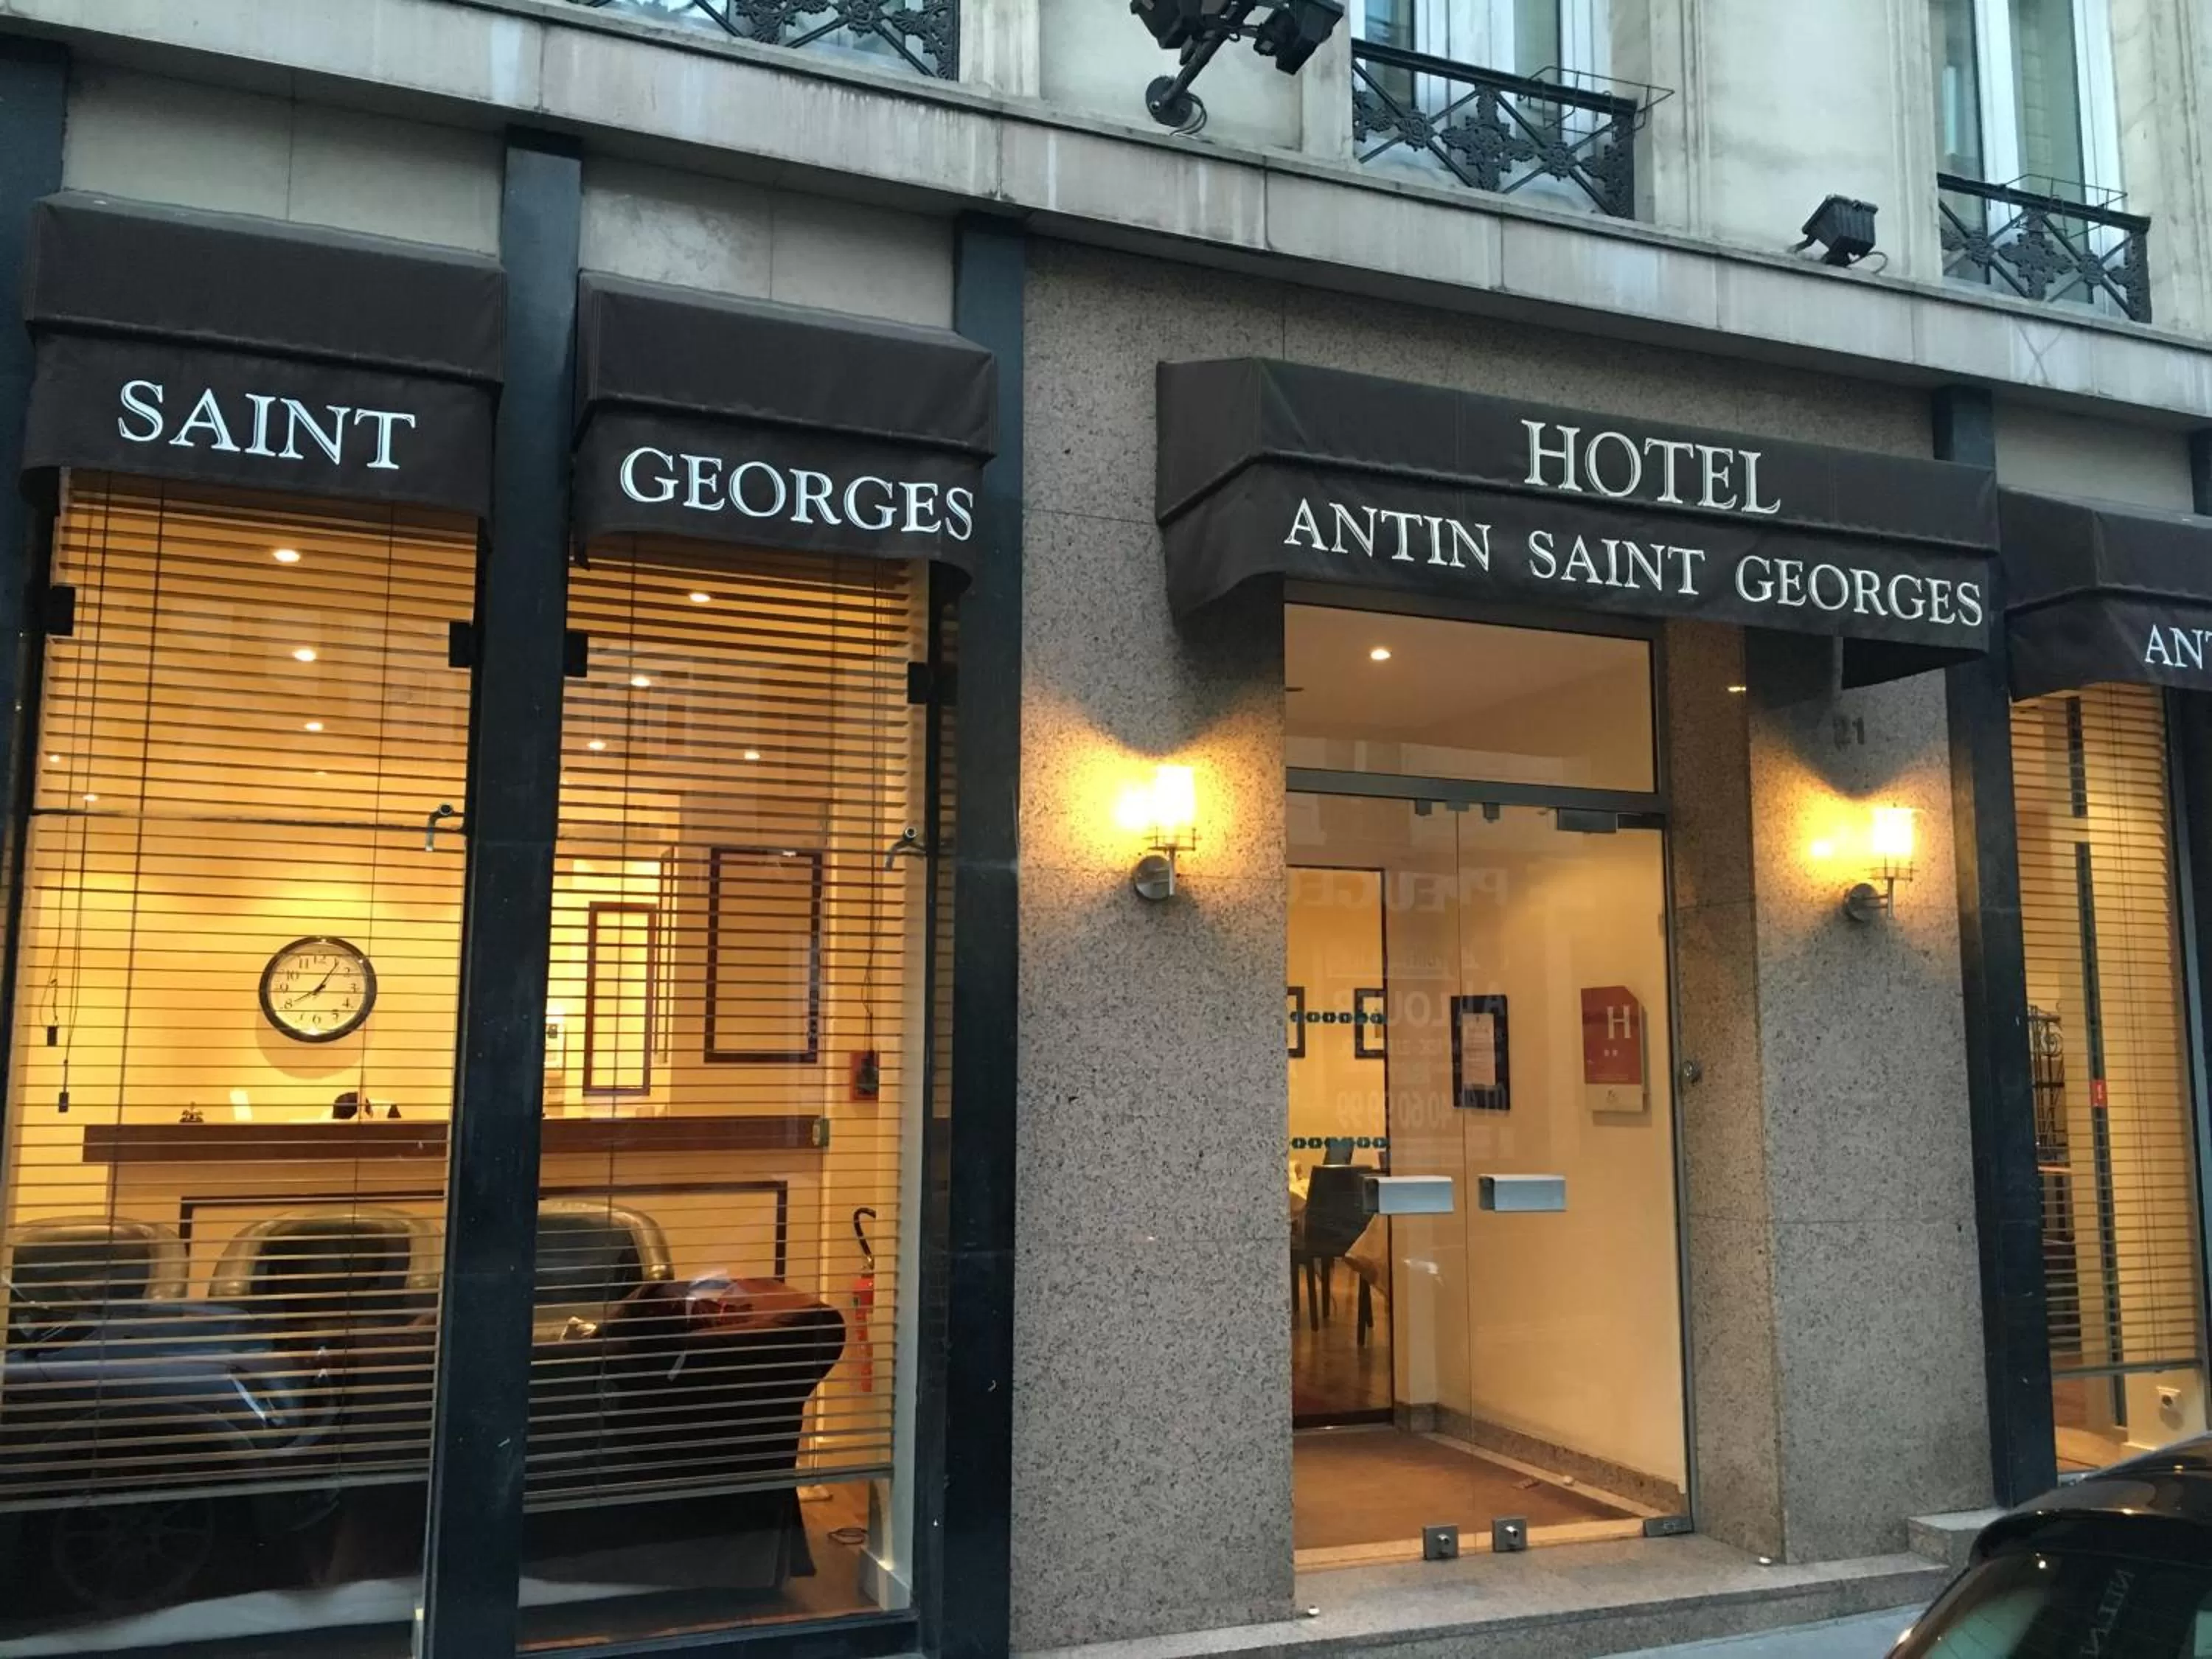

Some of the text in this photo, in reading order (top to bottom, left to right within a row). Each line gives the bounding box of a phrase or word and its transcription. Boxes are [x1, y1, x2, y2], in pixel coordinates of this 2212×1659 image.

[117, 380, 416, 470] SAINT
[1520, 419, 1781, 515] HOTEL
[619, 446, 973, 541] GEORGES
[1284, 498, 1983, 627] ANTIN SAINT GEORGES
[1607, 1005, 1632, 1039] H
